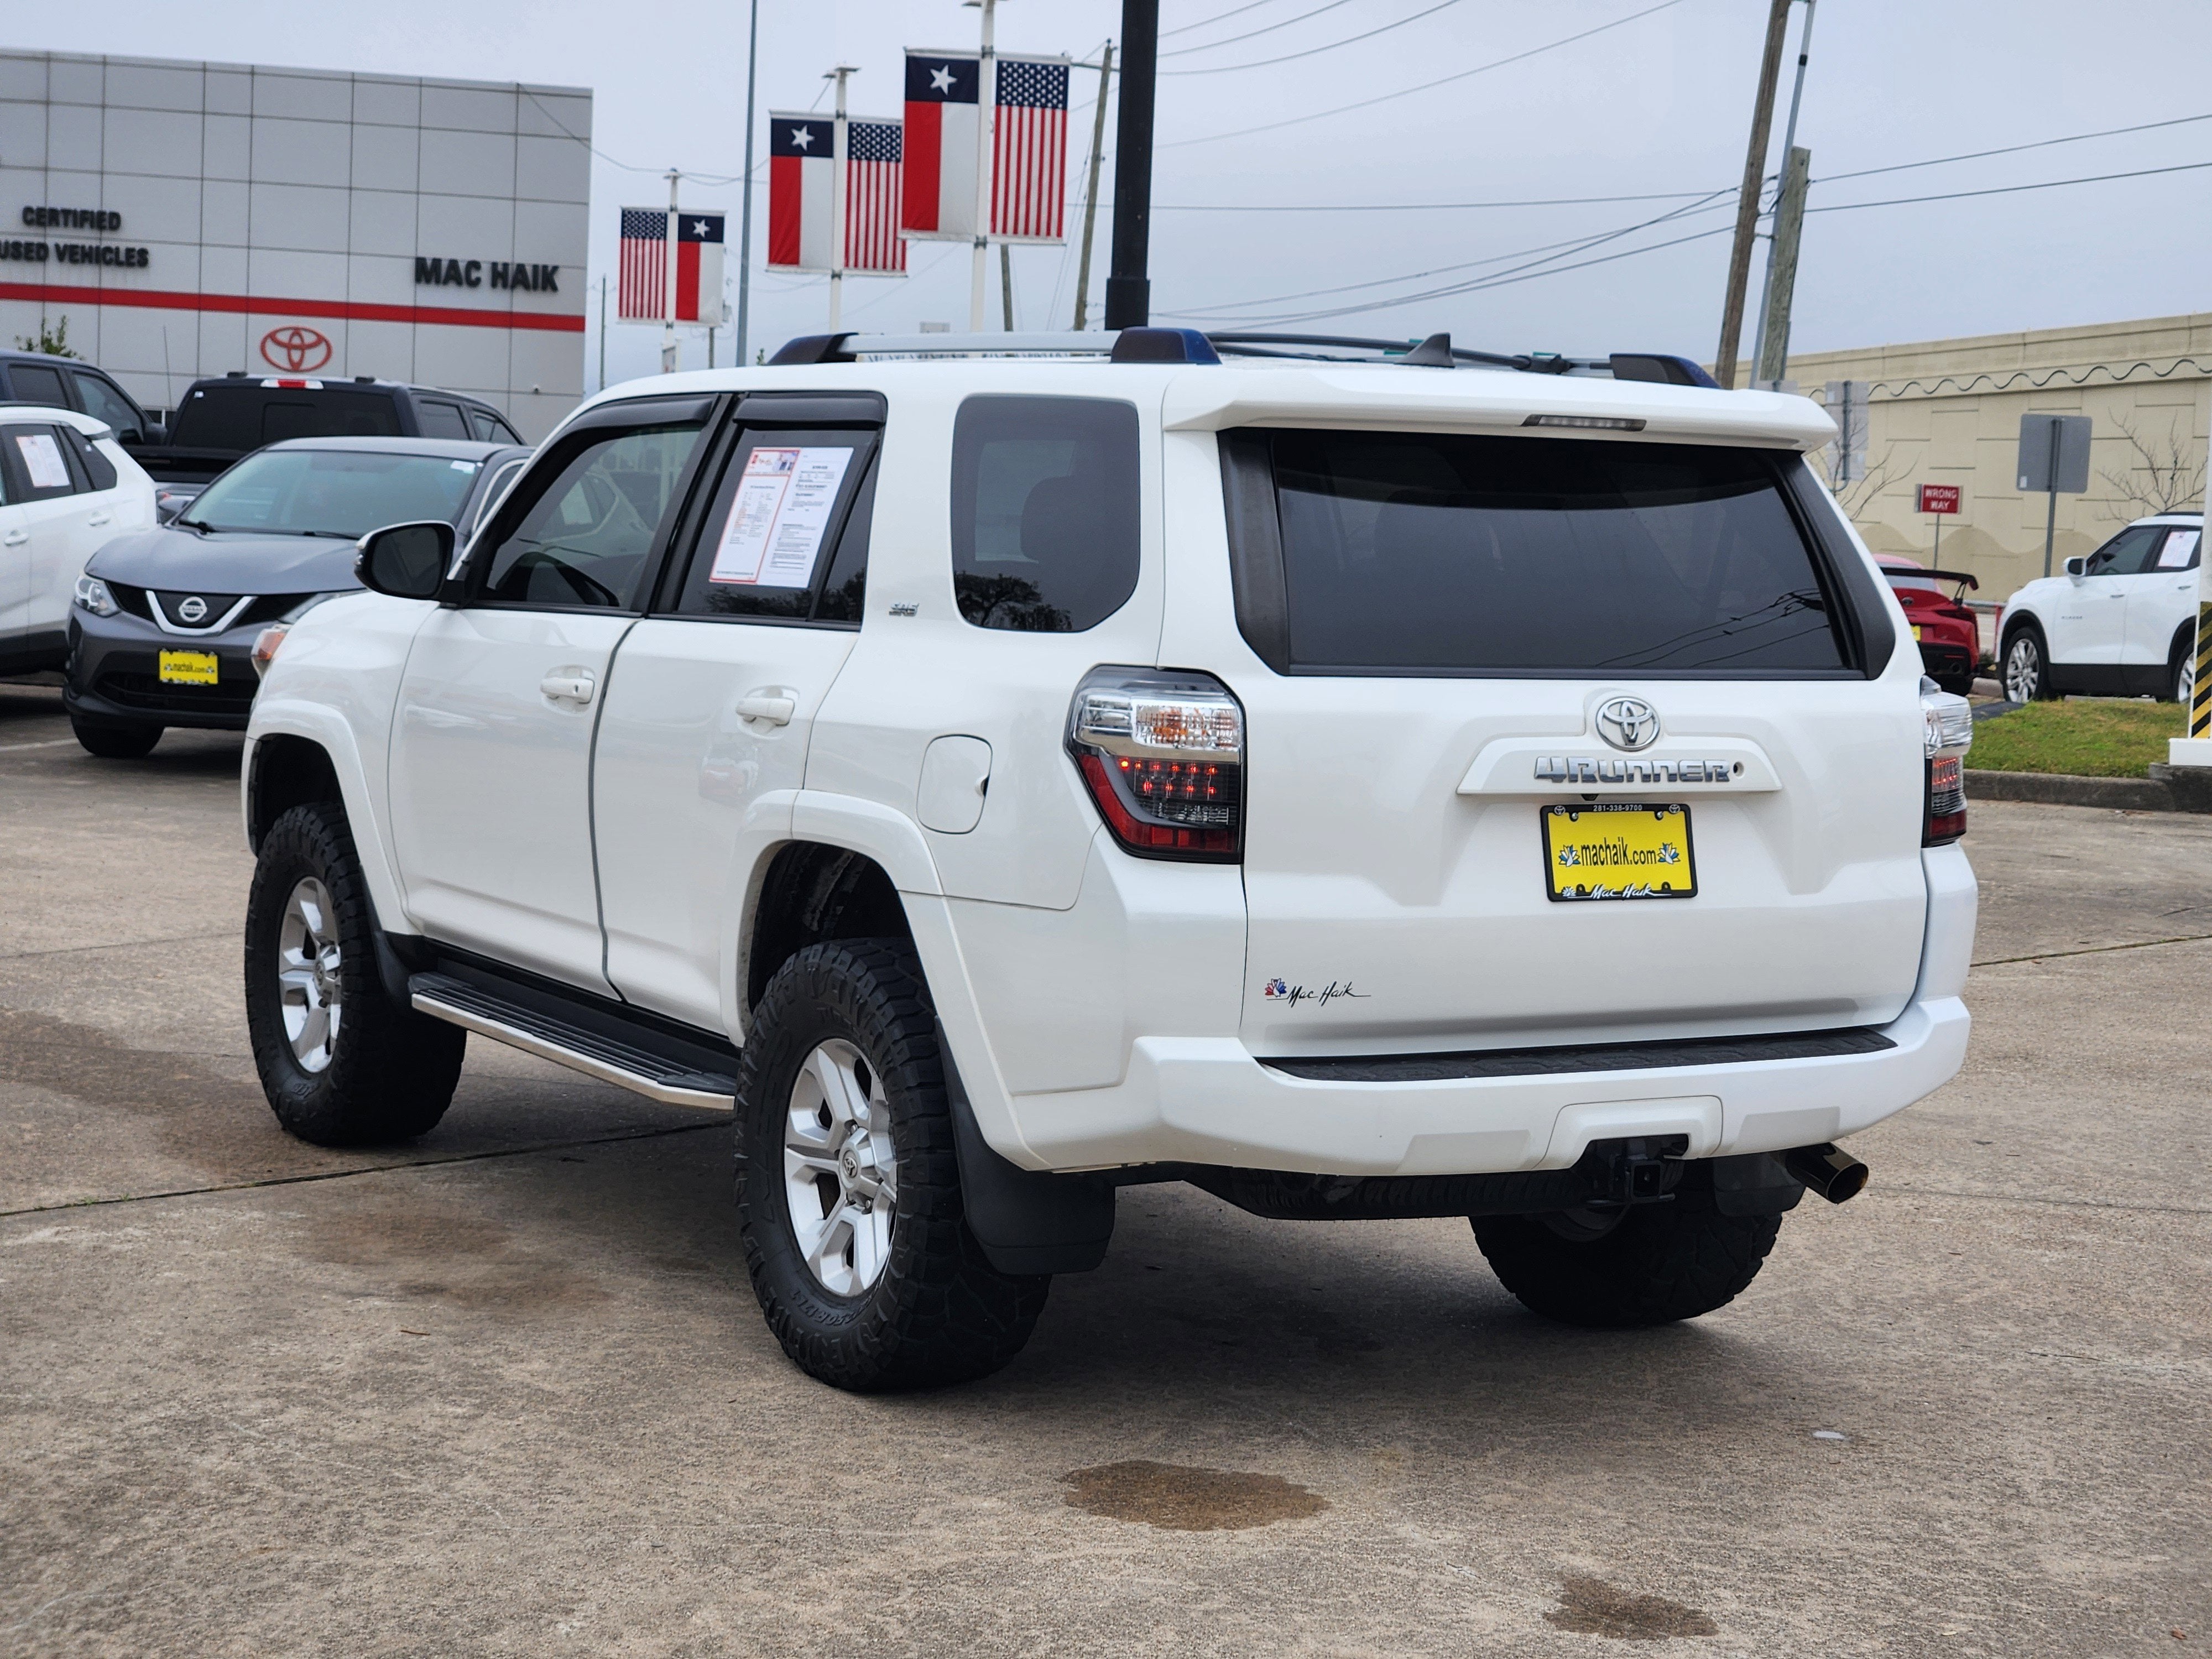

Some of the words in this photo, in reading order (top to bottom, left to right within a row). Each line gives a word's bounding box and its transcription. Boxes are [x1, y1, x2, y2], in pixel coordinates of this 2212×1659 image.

[23, 205, 121, 231] CERTIFIED
[0, 240, 49, 262] USED
[54, 243, 149, 267] VEHICLES
[415, 257, 482, 288] MAC
[491, 262, 559, 292] HAIK
[1925, 488, 1957, 499] WRONG
[1930, 500, 1950, 510] WAY
[1580, 836, 1657, 867] machaik.com
[1583, 884, 1620, 899] Mac
[1283, 985, 1318, 1008] Mac
[1318, 981, 1359, 1007] Haik
